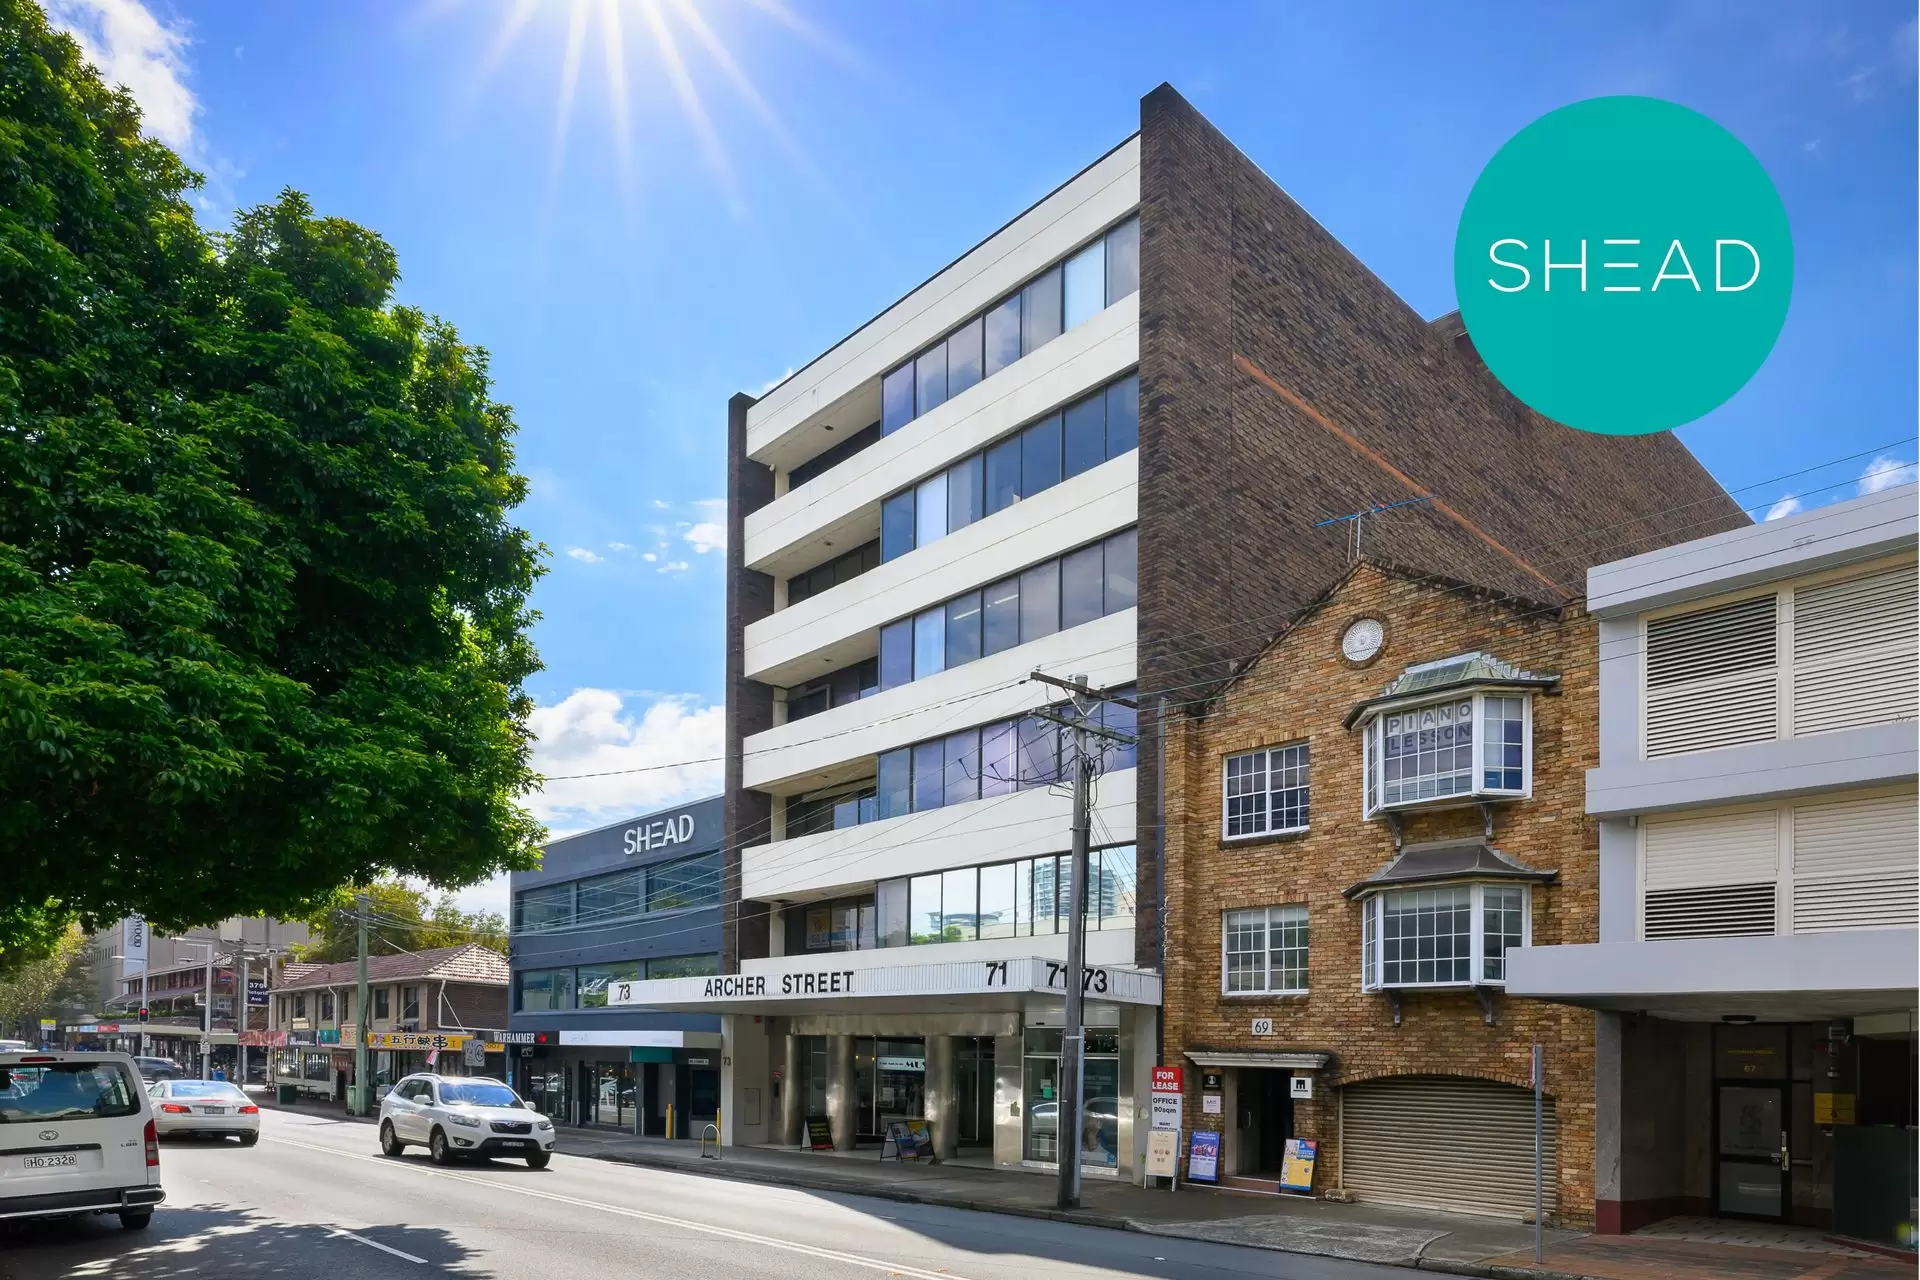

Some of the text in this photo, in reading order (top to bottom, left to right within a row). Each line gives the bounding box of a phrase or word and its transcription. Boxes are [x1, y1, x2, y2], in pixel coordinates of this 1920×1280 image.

[1389, 704, 1471, 733] PIANO
[1390, 724, 1471, 751] LESSON
[623, 814, 695, 855] SHEAD
[986, 961, 1007, 986] 71
[704, 971, 854, 997] ARCHER STREET
[618, 983, 631, 1001] 73
[1254, 1020, 1269, 1034] 69
[493, 1031, 535, 1044] WARHAMMER
[722, 1056, 732, 1067] 73
[1156, 1071, 1175, 1080] FOR
[1152, 1081, 1179, 1091] LEASE
[1152, 1097, 1178, 1105] OFFICE
[1153, 1106, 1177, 1115] 90sqm
